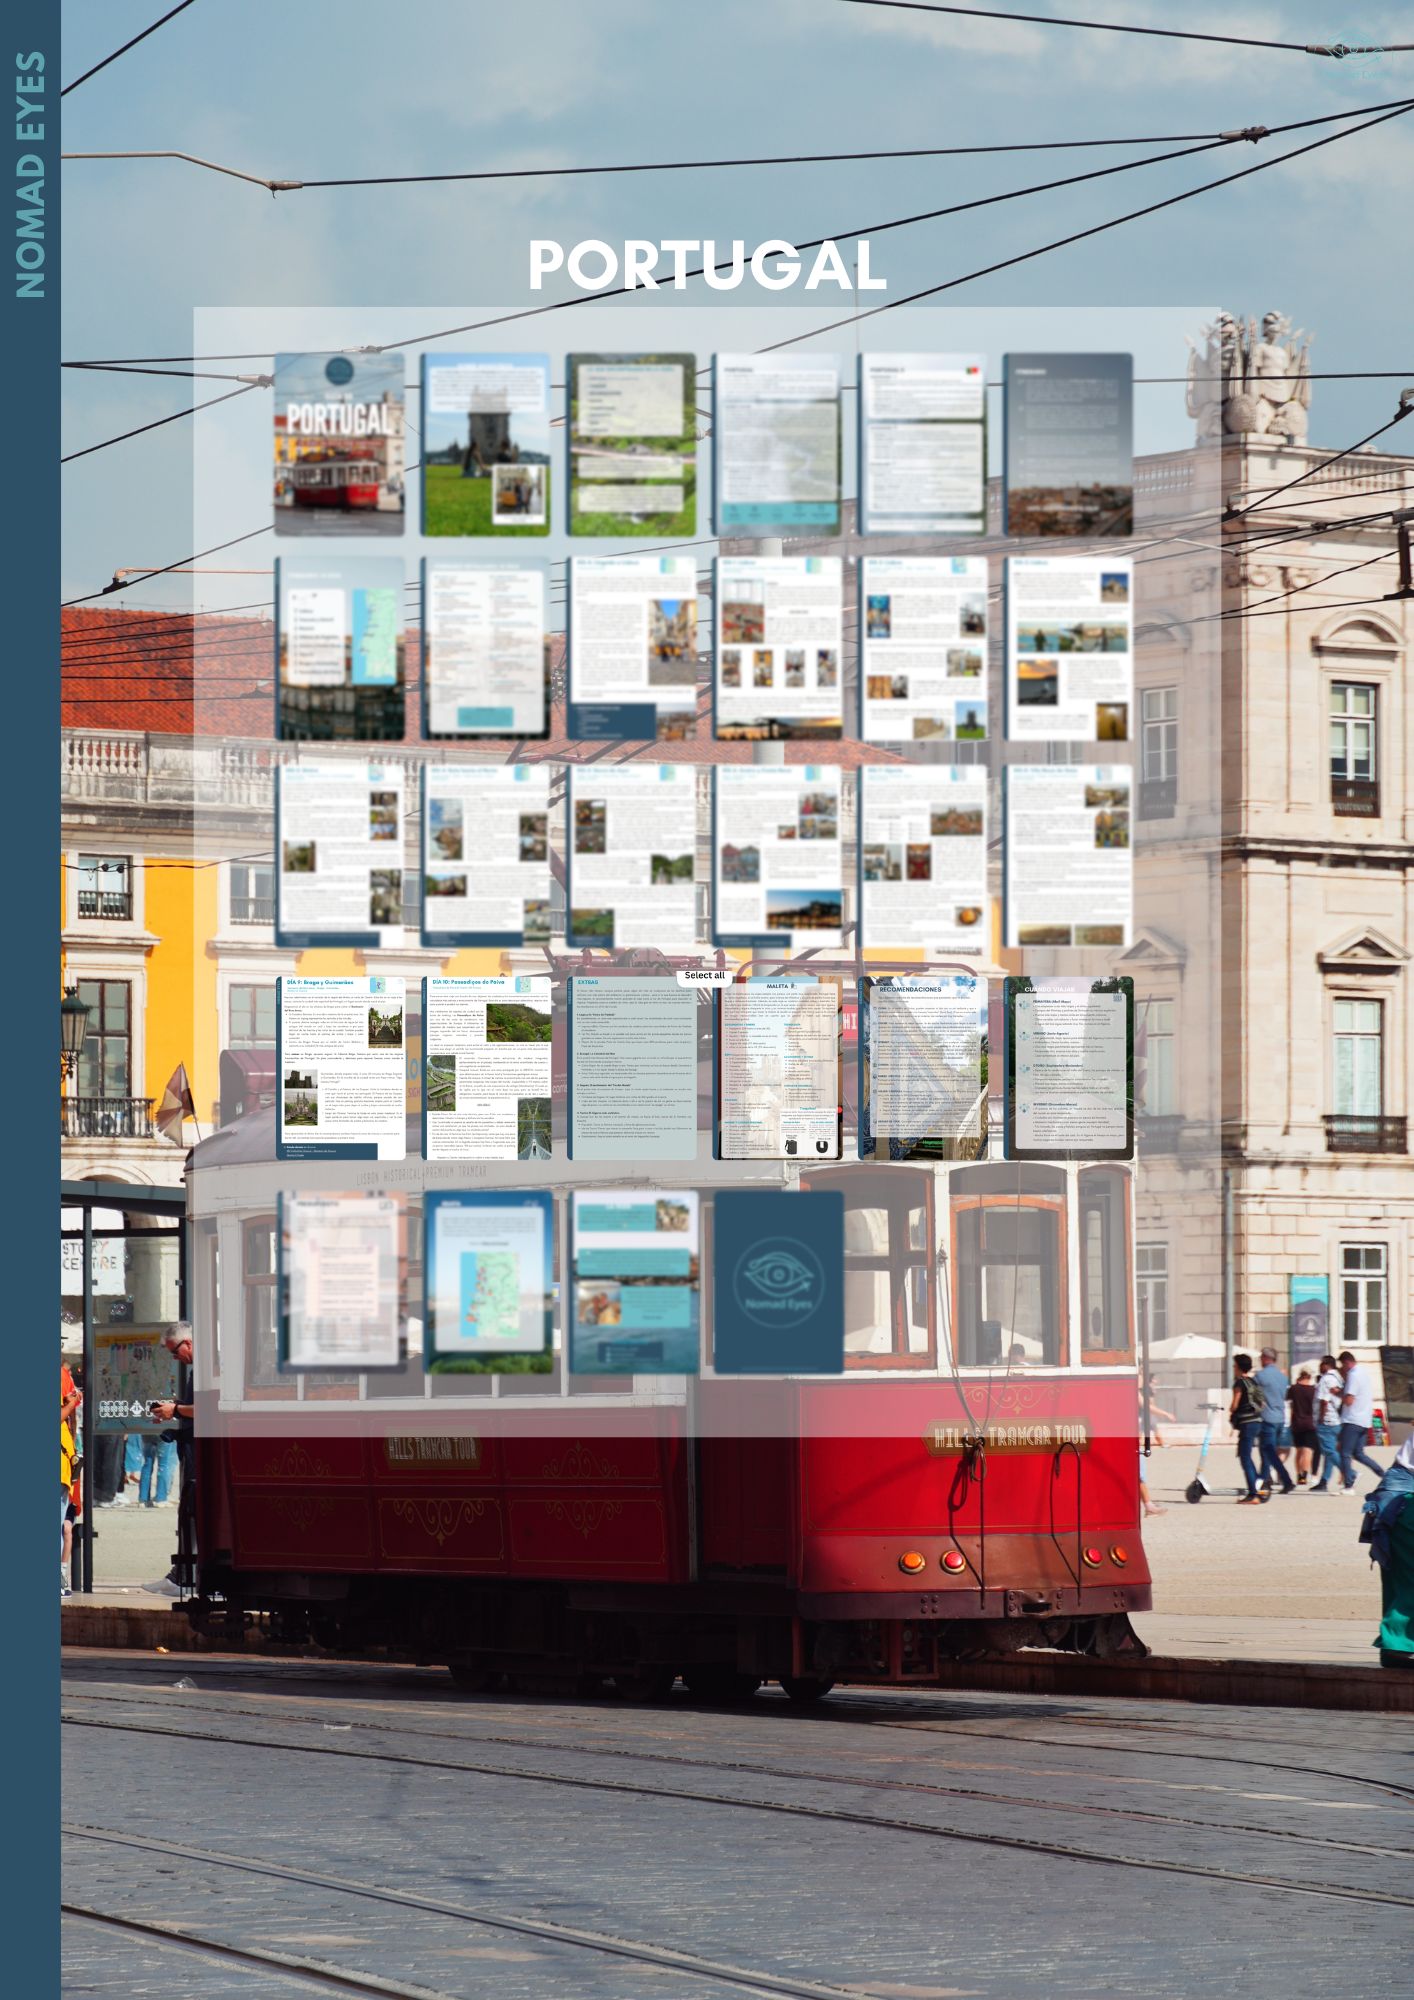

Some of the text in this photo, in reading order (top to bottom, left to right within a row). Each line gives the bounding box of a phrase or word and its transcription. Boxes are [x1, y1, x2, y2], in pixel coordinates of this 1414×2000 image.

[356, 1164, 487, 1186] LISBON HISTORICAL PREMIUM TRAMCAR
[988, 1425, 1051, 1447] TRAMCAR
[1054, 1424, 1087, 1445] TOUR
[388, 1436, 477, 1460] HILLS TRAMCAR TOUR
